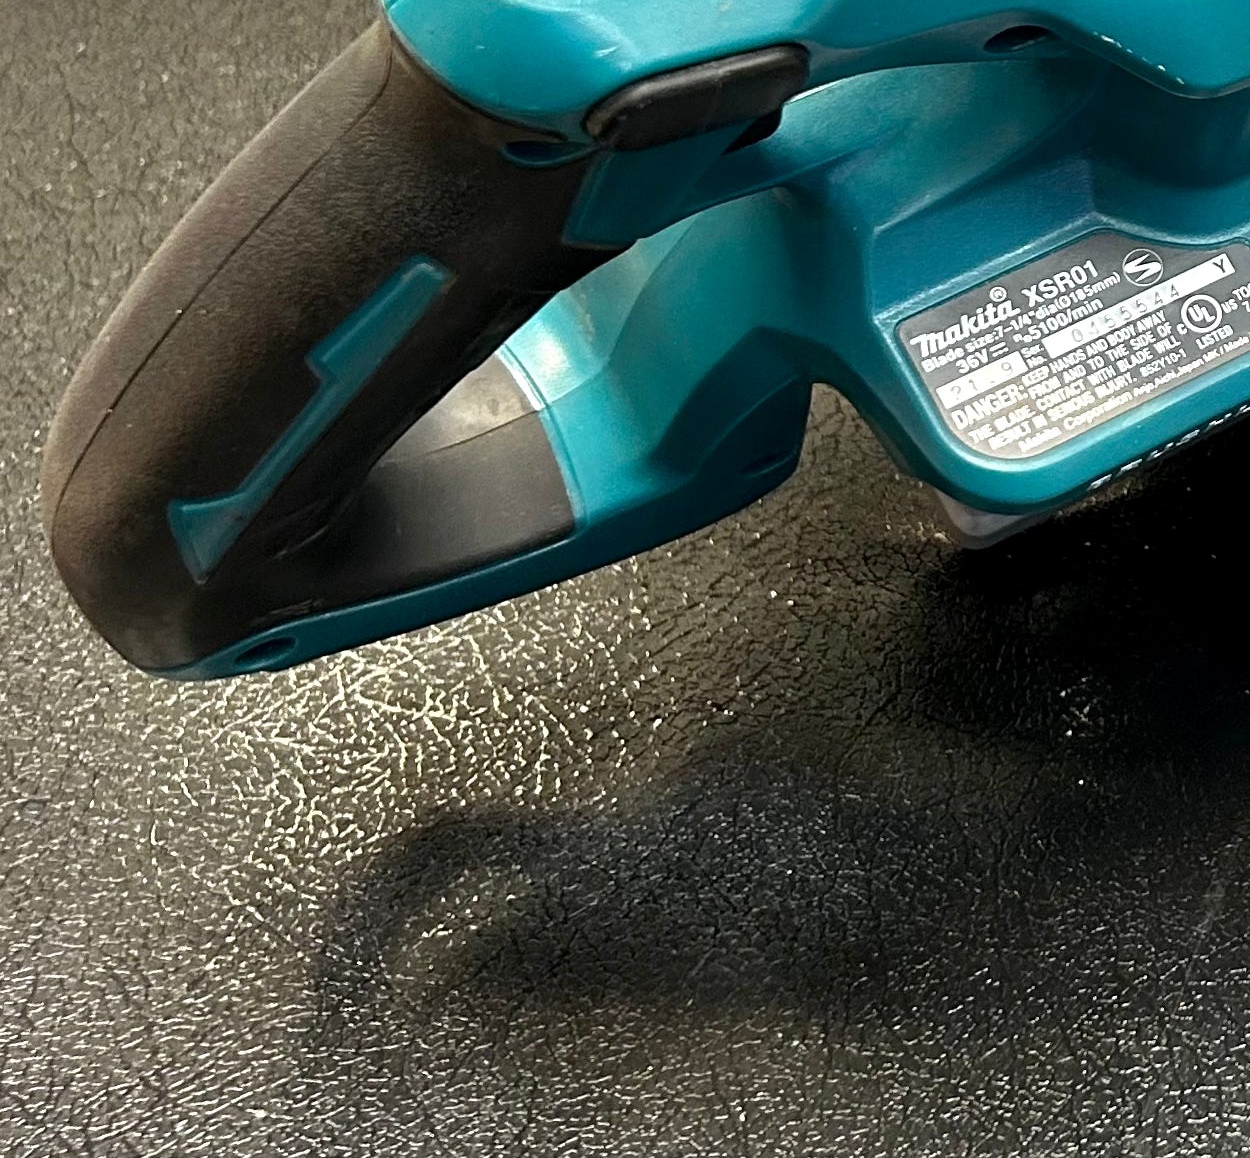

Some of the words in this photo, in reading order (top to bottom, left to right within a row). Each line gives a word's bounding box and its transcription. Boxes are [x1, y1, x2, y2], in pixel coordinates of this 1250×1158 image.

[1021, 260, 1098, 307] XSR01
[1211, 258, 1228, 275] Y
[921, 348, 965, 373] Blade
[1027, 376, 1061, 399] FROM
[1063, 364, 1086, 383] AND
[1086, 356, 1104, 370] TO
[1105, 344, 1129, 361] THE
[1129, 331, 1156, 350] SIDE
[1156, 322, 1172, 337] OF
[1195, 325, 1233, 349] LISTED
[950, 384, 1028, 430] DANGER:
[1021, 366, 1049, 387] KEEP
[1049, 349, 1086, 373] HANDS
[1086, 339, 1108, 357] AND
[1106, 324, 1136, 346] BODY
[1136, 310, 1165, 332] AWAY
[968, 423, 995, 443] THE
[1035, 379, 1086, 411] CONTACT
[1086, 365, 1116, 386] WITH
[1116, 347, 1153, 372] BLADE
[1153, 335, 1181, 354] WILL
[1063, 392, 1133, 431] Corporation
[1223, 336, 1249, 352] Made
[988, 421, 1031, 450] RESULT
[1032, 414, 1047, 428] IN
[1047, 391, 1095, 421] SERIOUS
